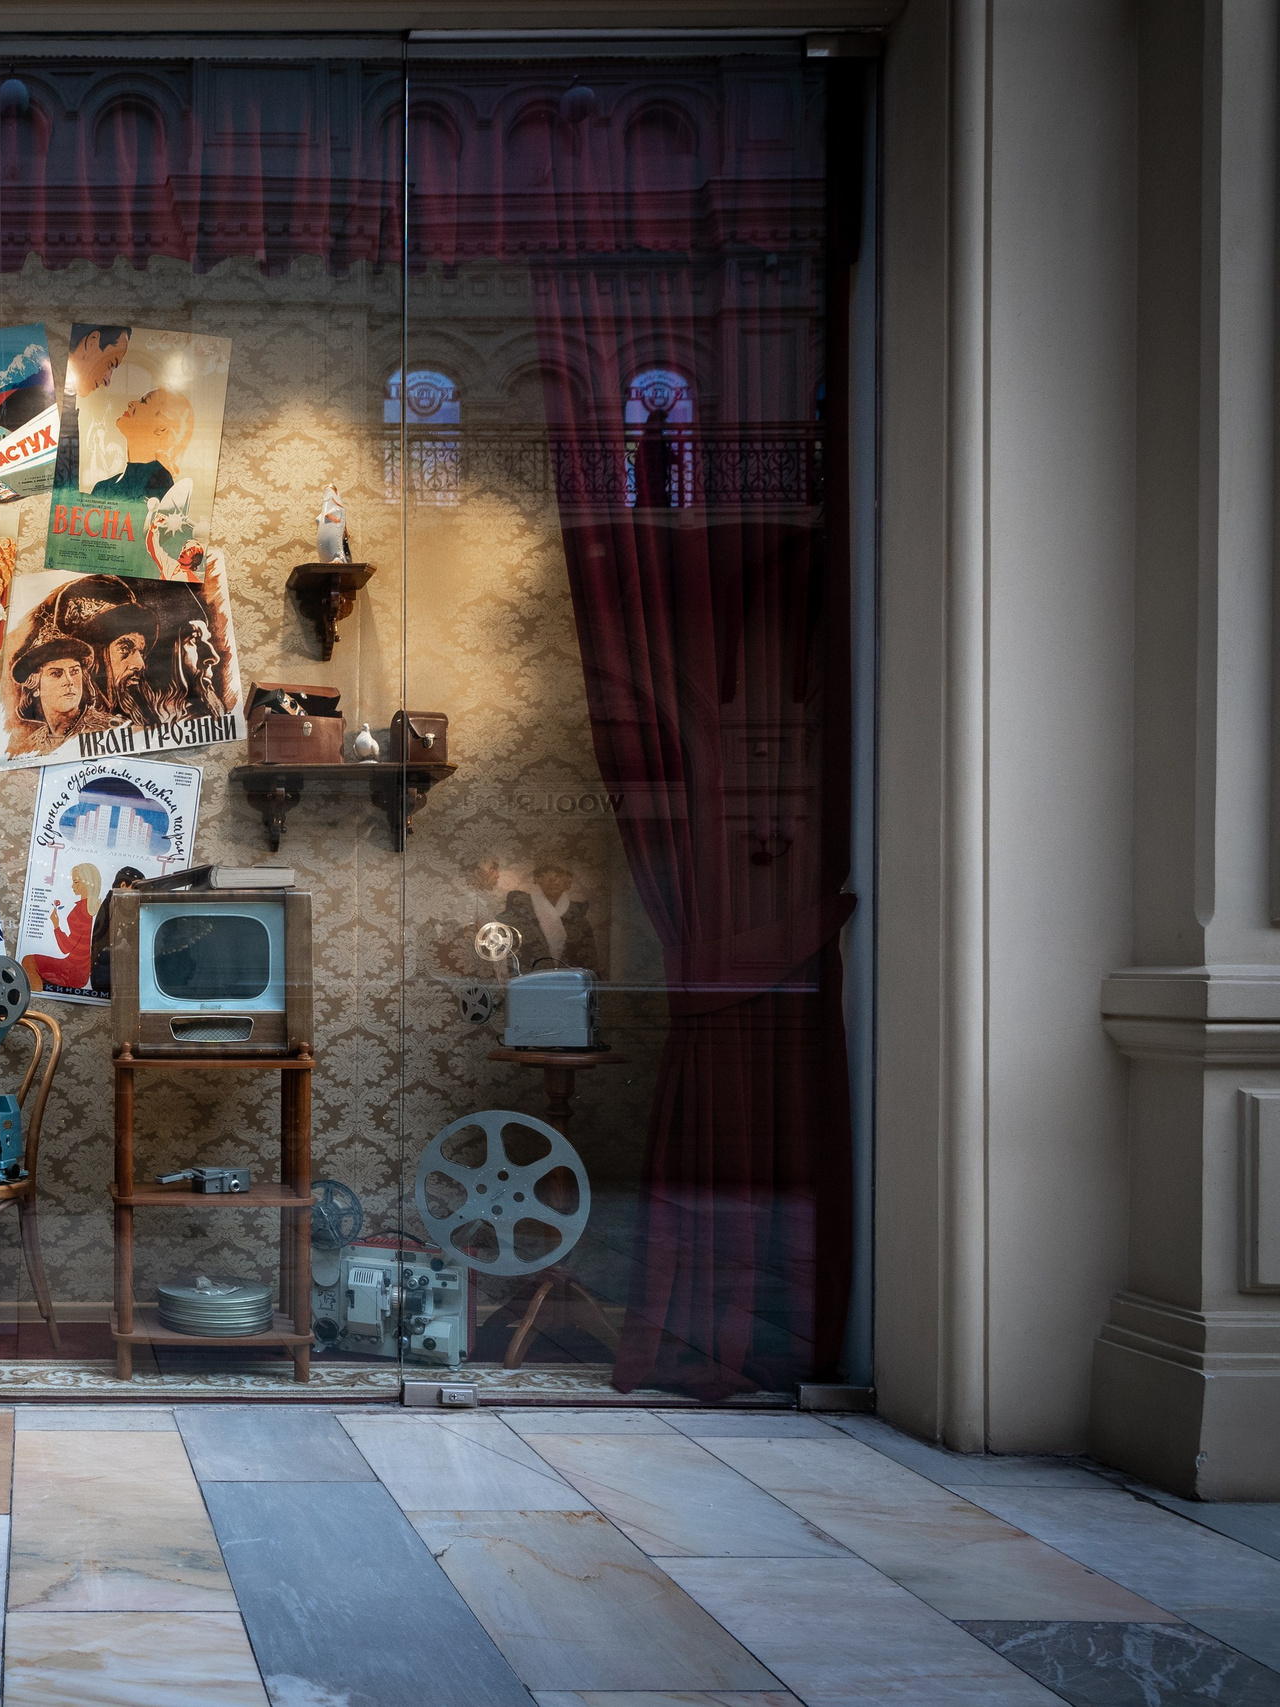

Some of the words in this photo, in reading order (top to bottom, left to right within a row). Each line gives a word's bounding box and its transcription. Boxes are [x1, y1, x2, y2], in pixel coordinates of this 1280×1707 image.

[52, 504, 136, 542] ВЕСНА
[78, 726, 135, 758] ИВАН
[144, 712, 238, 750] ГРОЗНЫЙ
[36, 792, 71, 847] Ирония
[161, 815, 186, 862] паром!
[64, 846, 100, 855] МОСКВА
